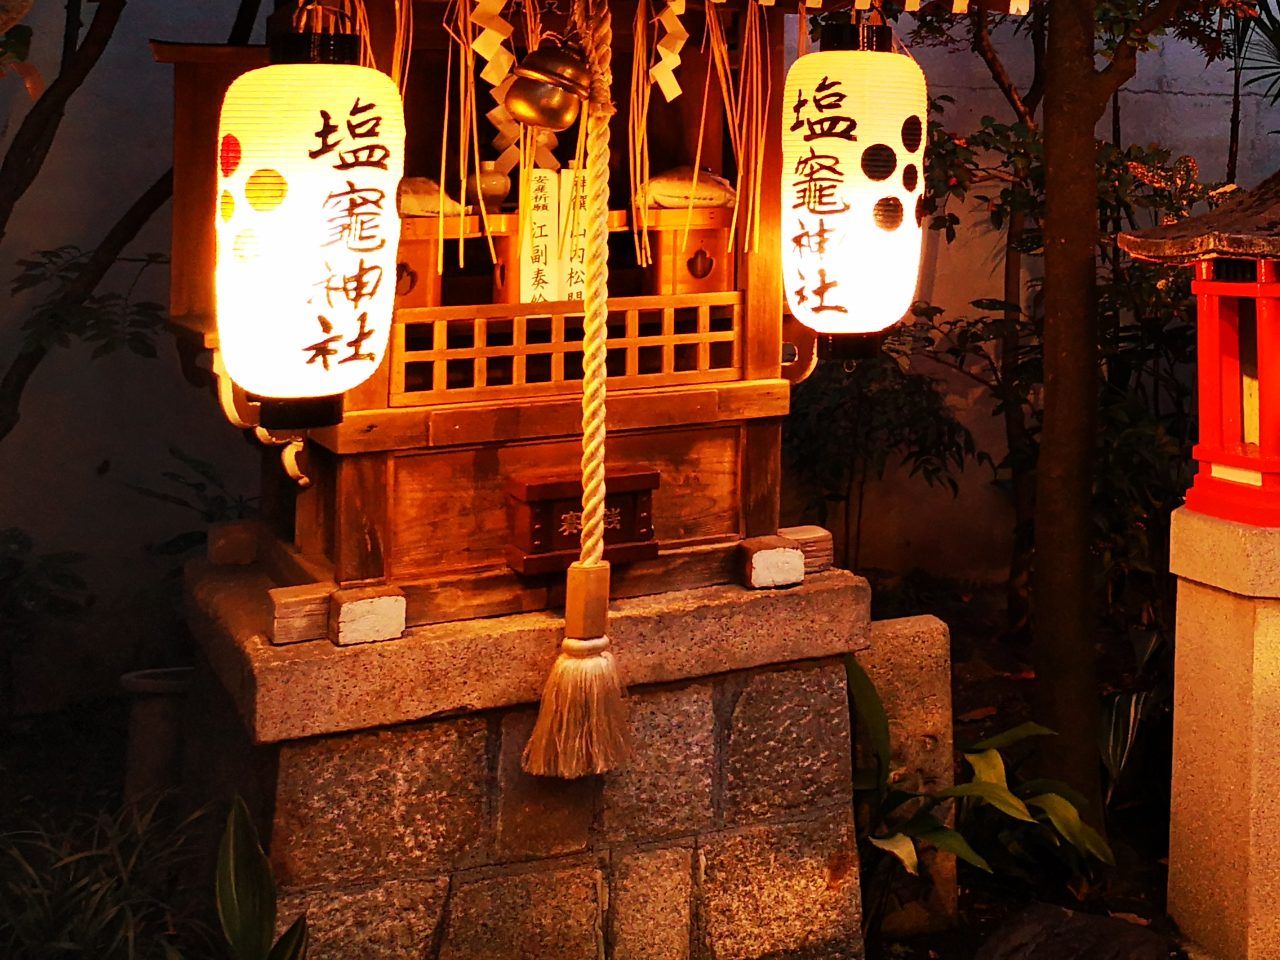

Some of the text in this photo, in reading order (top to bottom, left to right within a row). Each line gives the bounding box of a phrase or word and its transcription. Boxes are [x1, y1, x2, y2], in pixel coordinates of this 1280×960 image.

[302, 96, 391, 371] 塩竈神社
[790, 76, 858, 314] 塩竈神社
